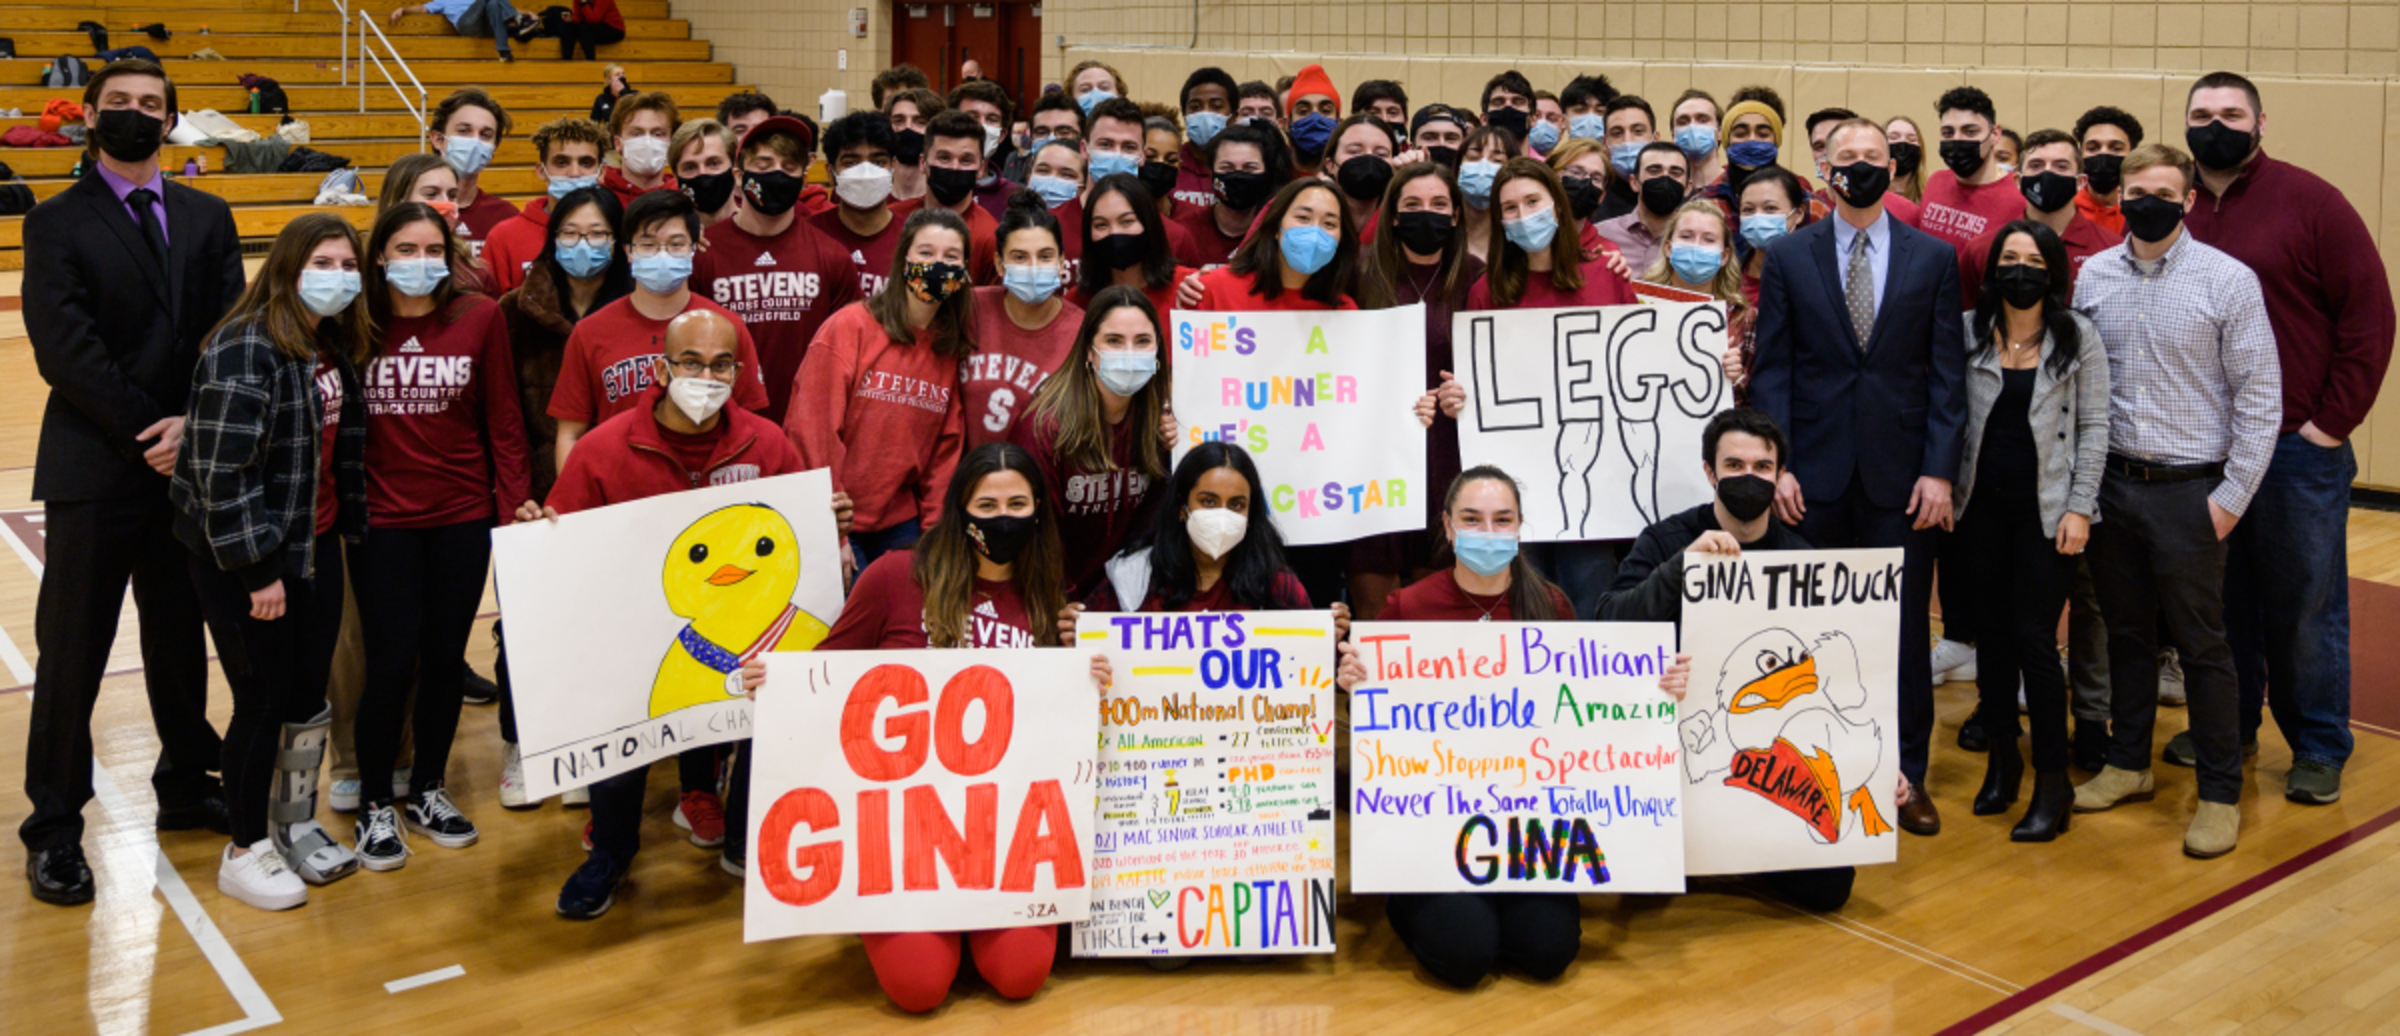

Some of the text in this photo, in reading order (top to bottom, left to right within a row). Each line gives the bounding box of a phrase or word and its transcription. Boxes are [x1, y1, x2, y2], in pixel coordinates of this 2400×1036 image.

[1923, 202, 1987, 234] STEVENS
[713, 271, 821, 303] STEVENS
[741, 312, 764, 324] RACK
[773, 310, 801, 322] FIELD
[1179, 316, 1329, 358] SHE'S A
[365, 355, 473, 387] TEVENS
[862, 370, 949, 403] STEVENS
[960, 353, 1050, 394] STEVE
[1471, 304, 1726, 432] LEGS
[983, 388, 1016, 432] S
[1221, 372, 1358, 410] RUNNER
[1300, 422, 1325, 452] A
[1260, 478, 1407, 519] CKSTAR
[1682, 560, 1904, 610] GINA THE DUCK
[1110, 612, 1246, 650] THAT'S
[1359, 627, 1671, 681] Talented Brilliant
[1162, 691, 1244, 722] National
[1253, 693, 1317, 726] Champ!
[1353, 683, 1676, 732] Incredible Amazing
[553, 723, 695, 787] NATIONAL
[1232, 731, 1250, 748] 27
[1228, 763, 1275, 783] PHD
[1356, 737, 1680, 788] Show Stopping Spectacular
[1356, 787, 1436, 817] Never
[1438, 783, 1482, 815] The
[1541, 786, 1612, 827] Totally
[1614, 785, 1678, 826] Unique
[1735, 752, 1829, 826] DELAWARE
[758, 779, 1086, 907] GINA
[1124, 829, 1153, 846] MAC
[1157, 826, 1199, 843] SENIOR
[1202, 823, 1249, 840] SCHOLAR
[1252, 819, 1305, 836] ATHLETE
[1455, 813, 1611, 886] GINA
[1109, 897, 1145, 911] BENCH
[1177, 878, 1335, 949] CAPTAIN
[1077, 926, 1140, 950] THREE
